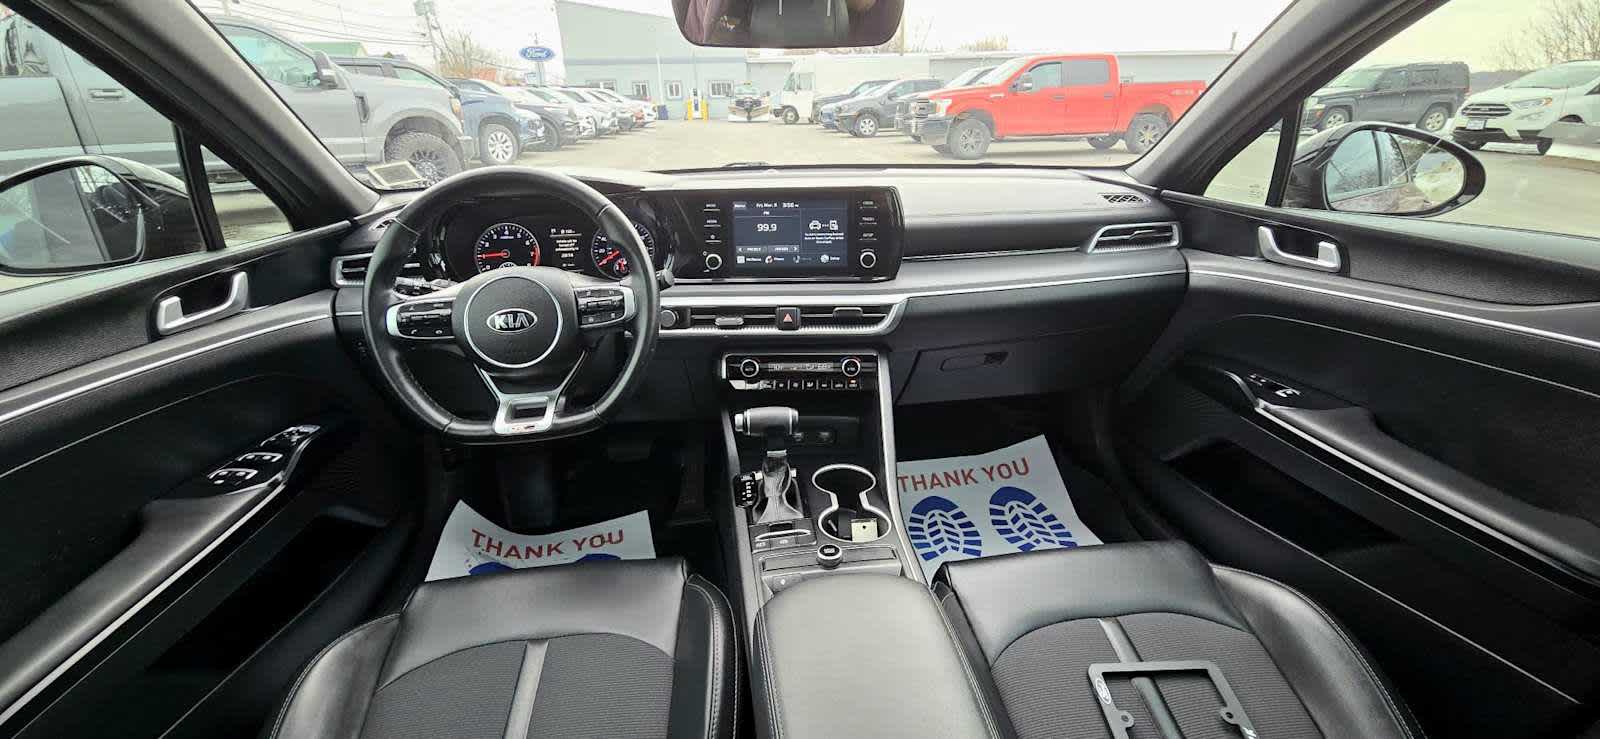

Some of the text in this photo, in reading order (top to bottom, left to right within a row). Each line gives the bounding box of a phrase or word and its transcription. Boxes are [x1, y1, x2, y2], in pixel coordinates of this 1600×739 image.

[757, 223, 778, 232] 99.9
[494, 312, 531, 330] KIA
[897, 457, 1031, 493] THANK YOU
[471, 528, 625, 560] THANK YOU
